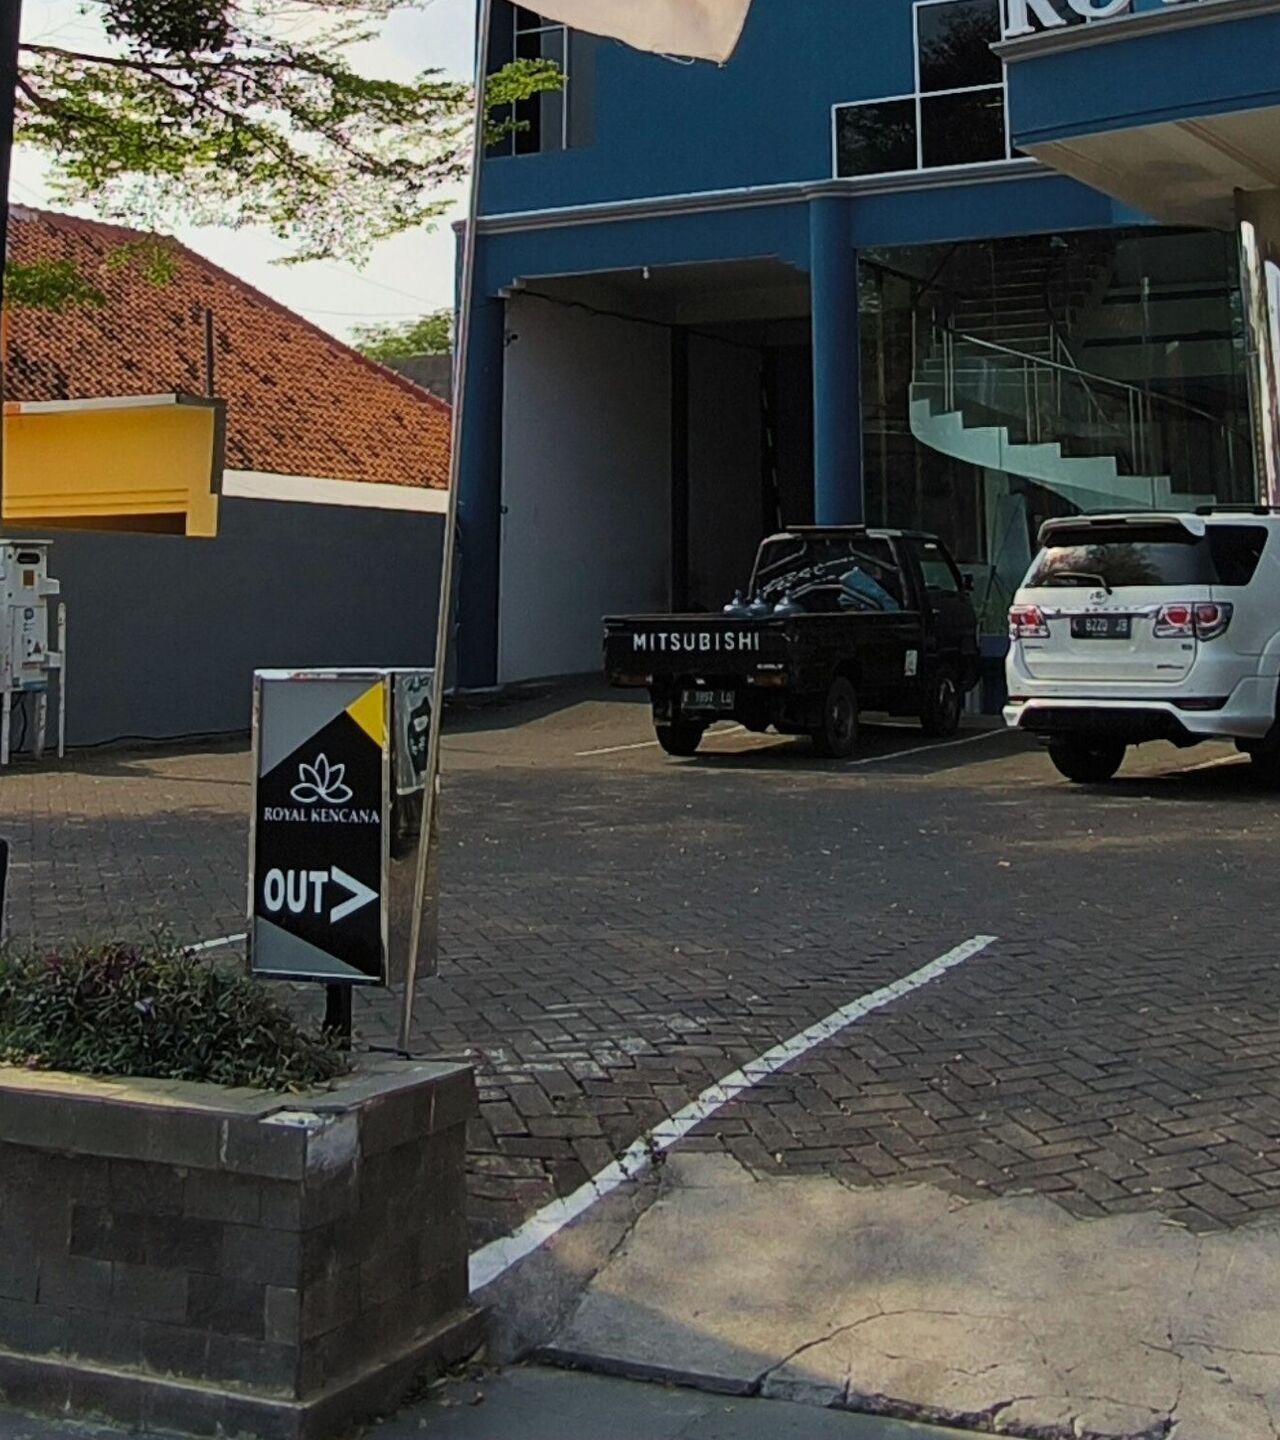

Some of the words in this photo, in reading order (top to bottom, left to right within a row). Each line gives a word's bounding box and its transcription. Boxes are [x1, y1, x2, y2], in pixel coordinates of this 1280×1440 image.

[633, 631, 760, 651] MITSUBISHI
[264, 806, 308, 822] ROYAL
[311, 808, 380, 824] KENCANA
[263, 867, 329, 913] OUT
